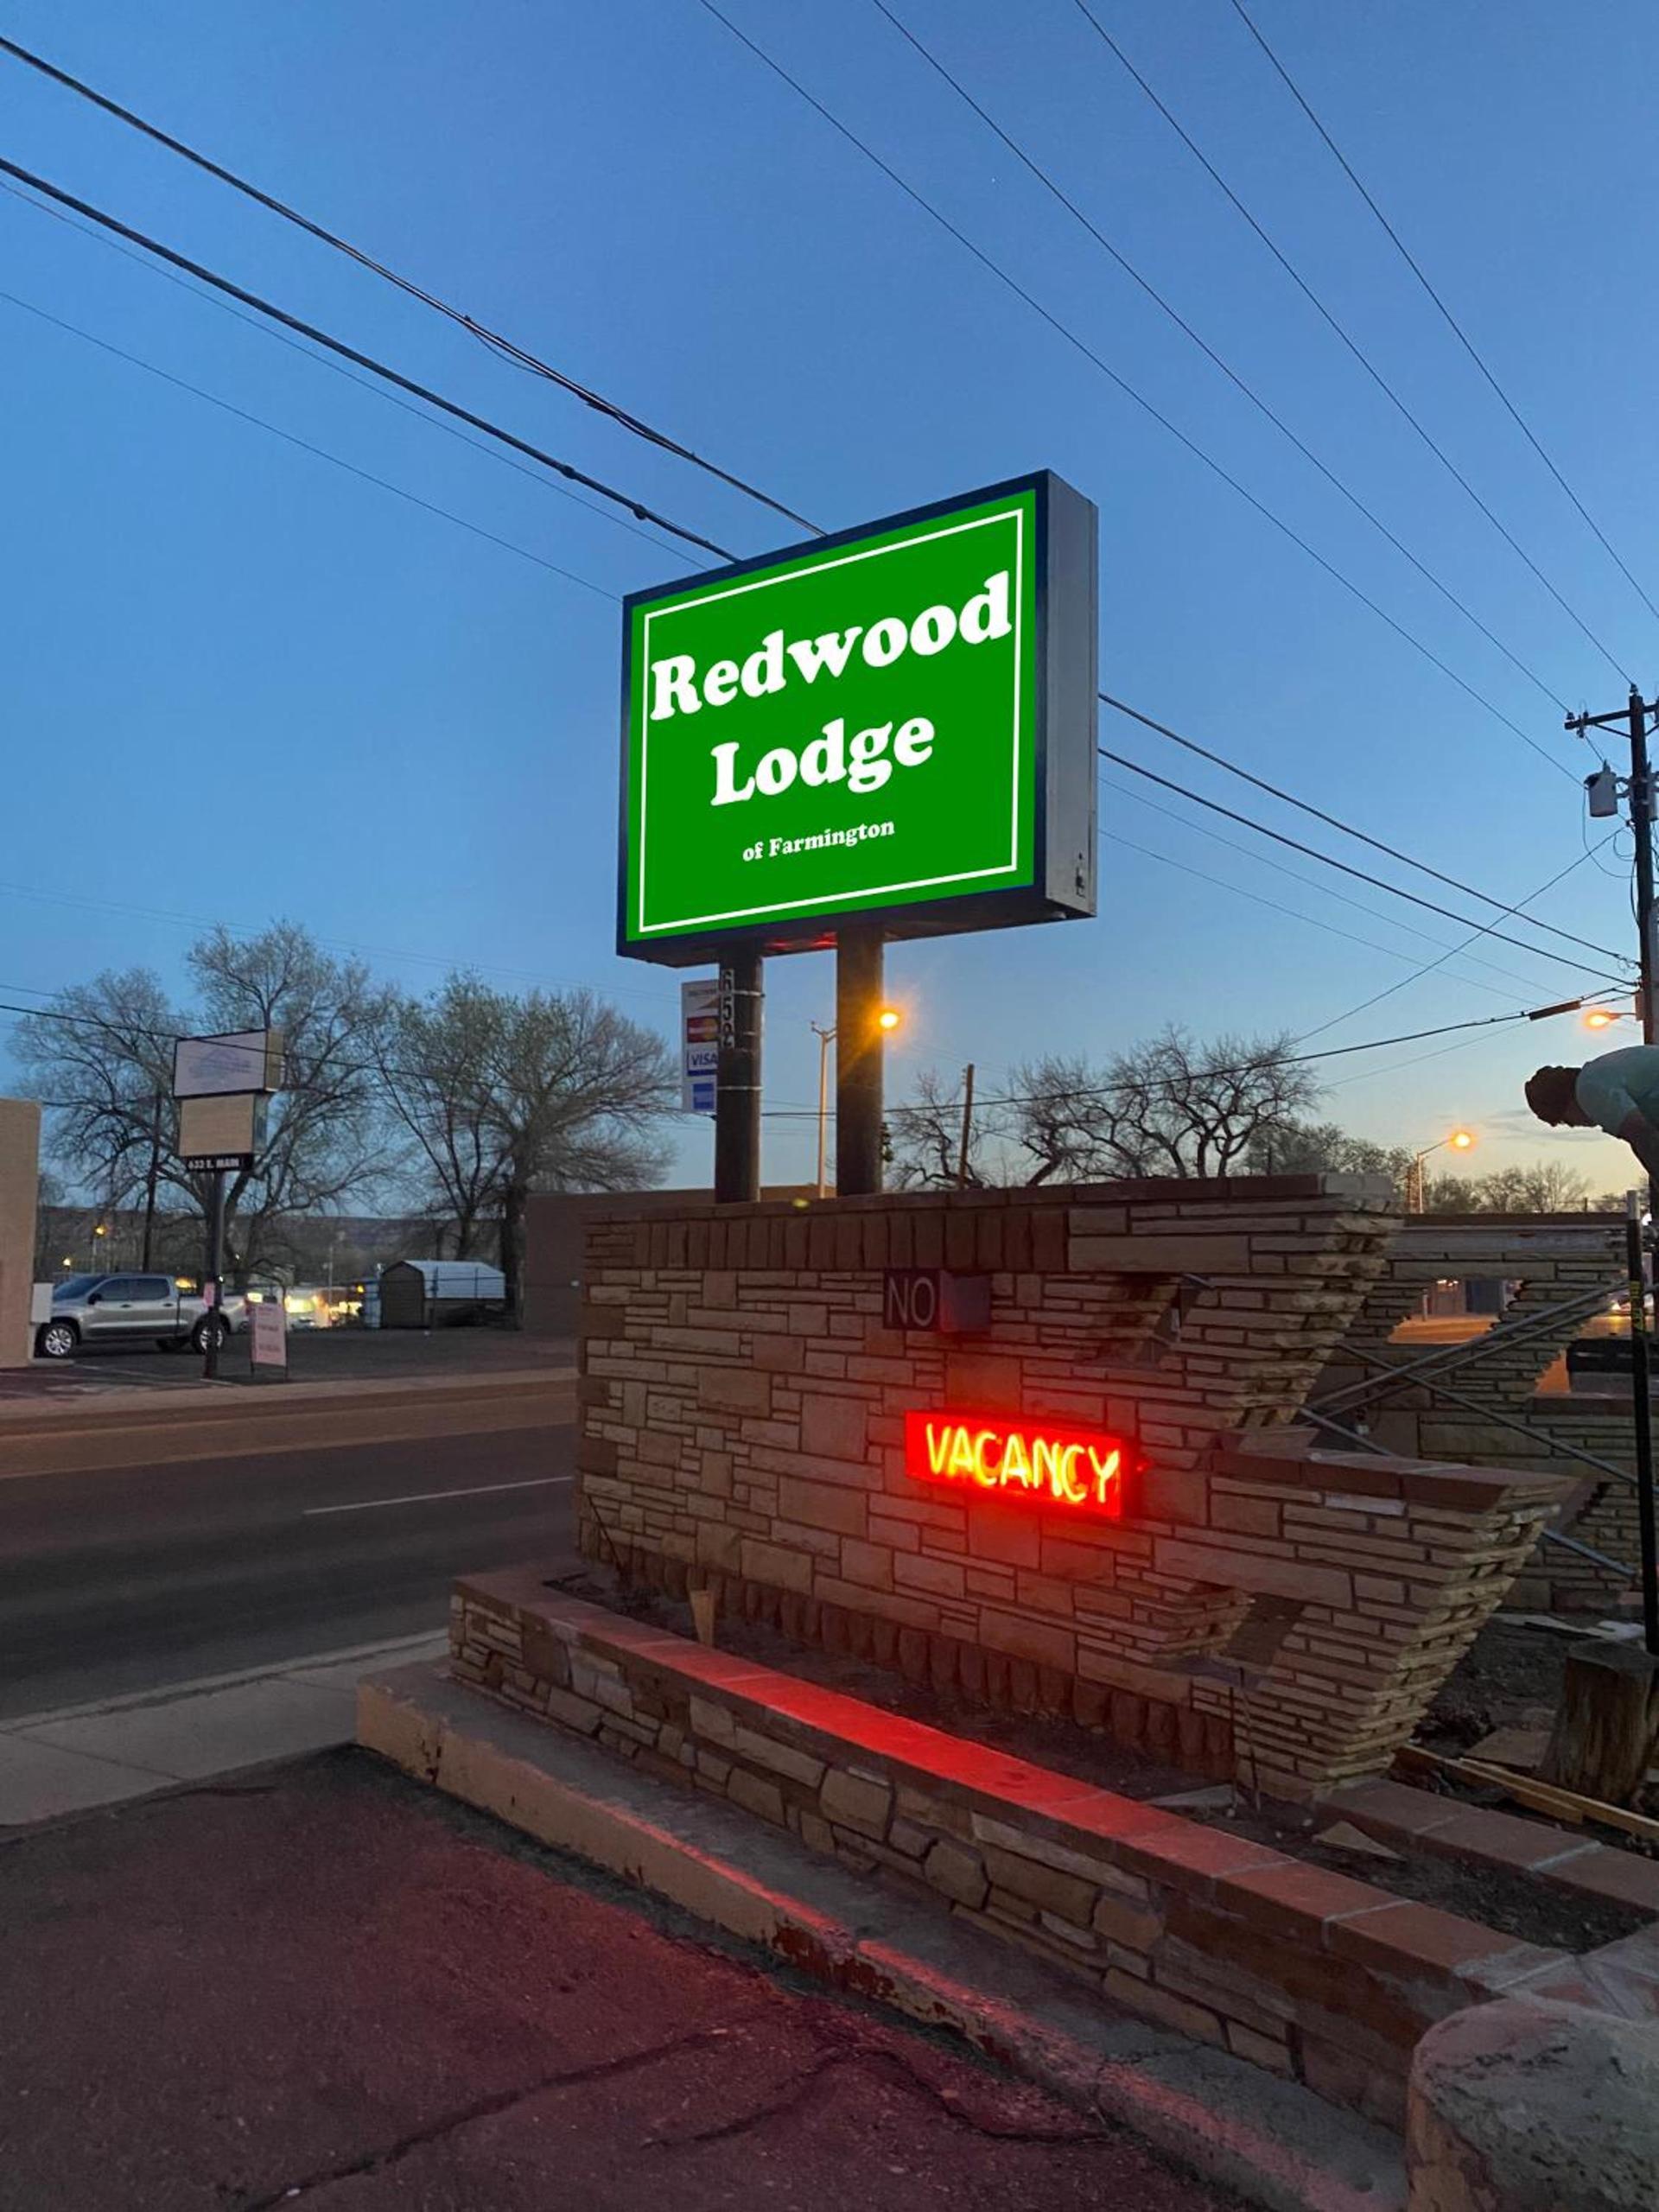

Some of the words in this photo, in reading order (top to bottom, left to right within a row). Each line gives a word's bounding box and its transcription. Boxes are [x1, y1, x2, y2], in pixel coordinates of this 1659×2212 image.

[650, 570, 1012, 721] Redwood
[710, 717, 935, 806] Lodge
[742, 842, 764, 862] of
[769, 821, 895, 857] Farmington
[692, 1052, 719, 1065] VISA
[887, 1276, 936, 1327] NO
[926, 1423, 1120, 1503] VACANCY
